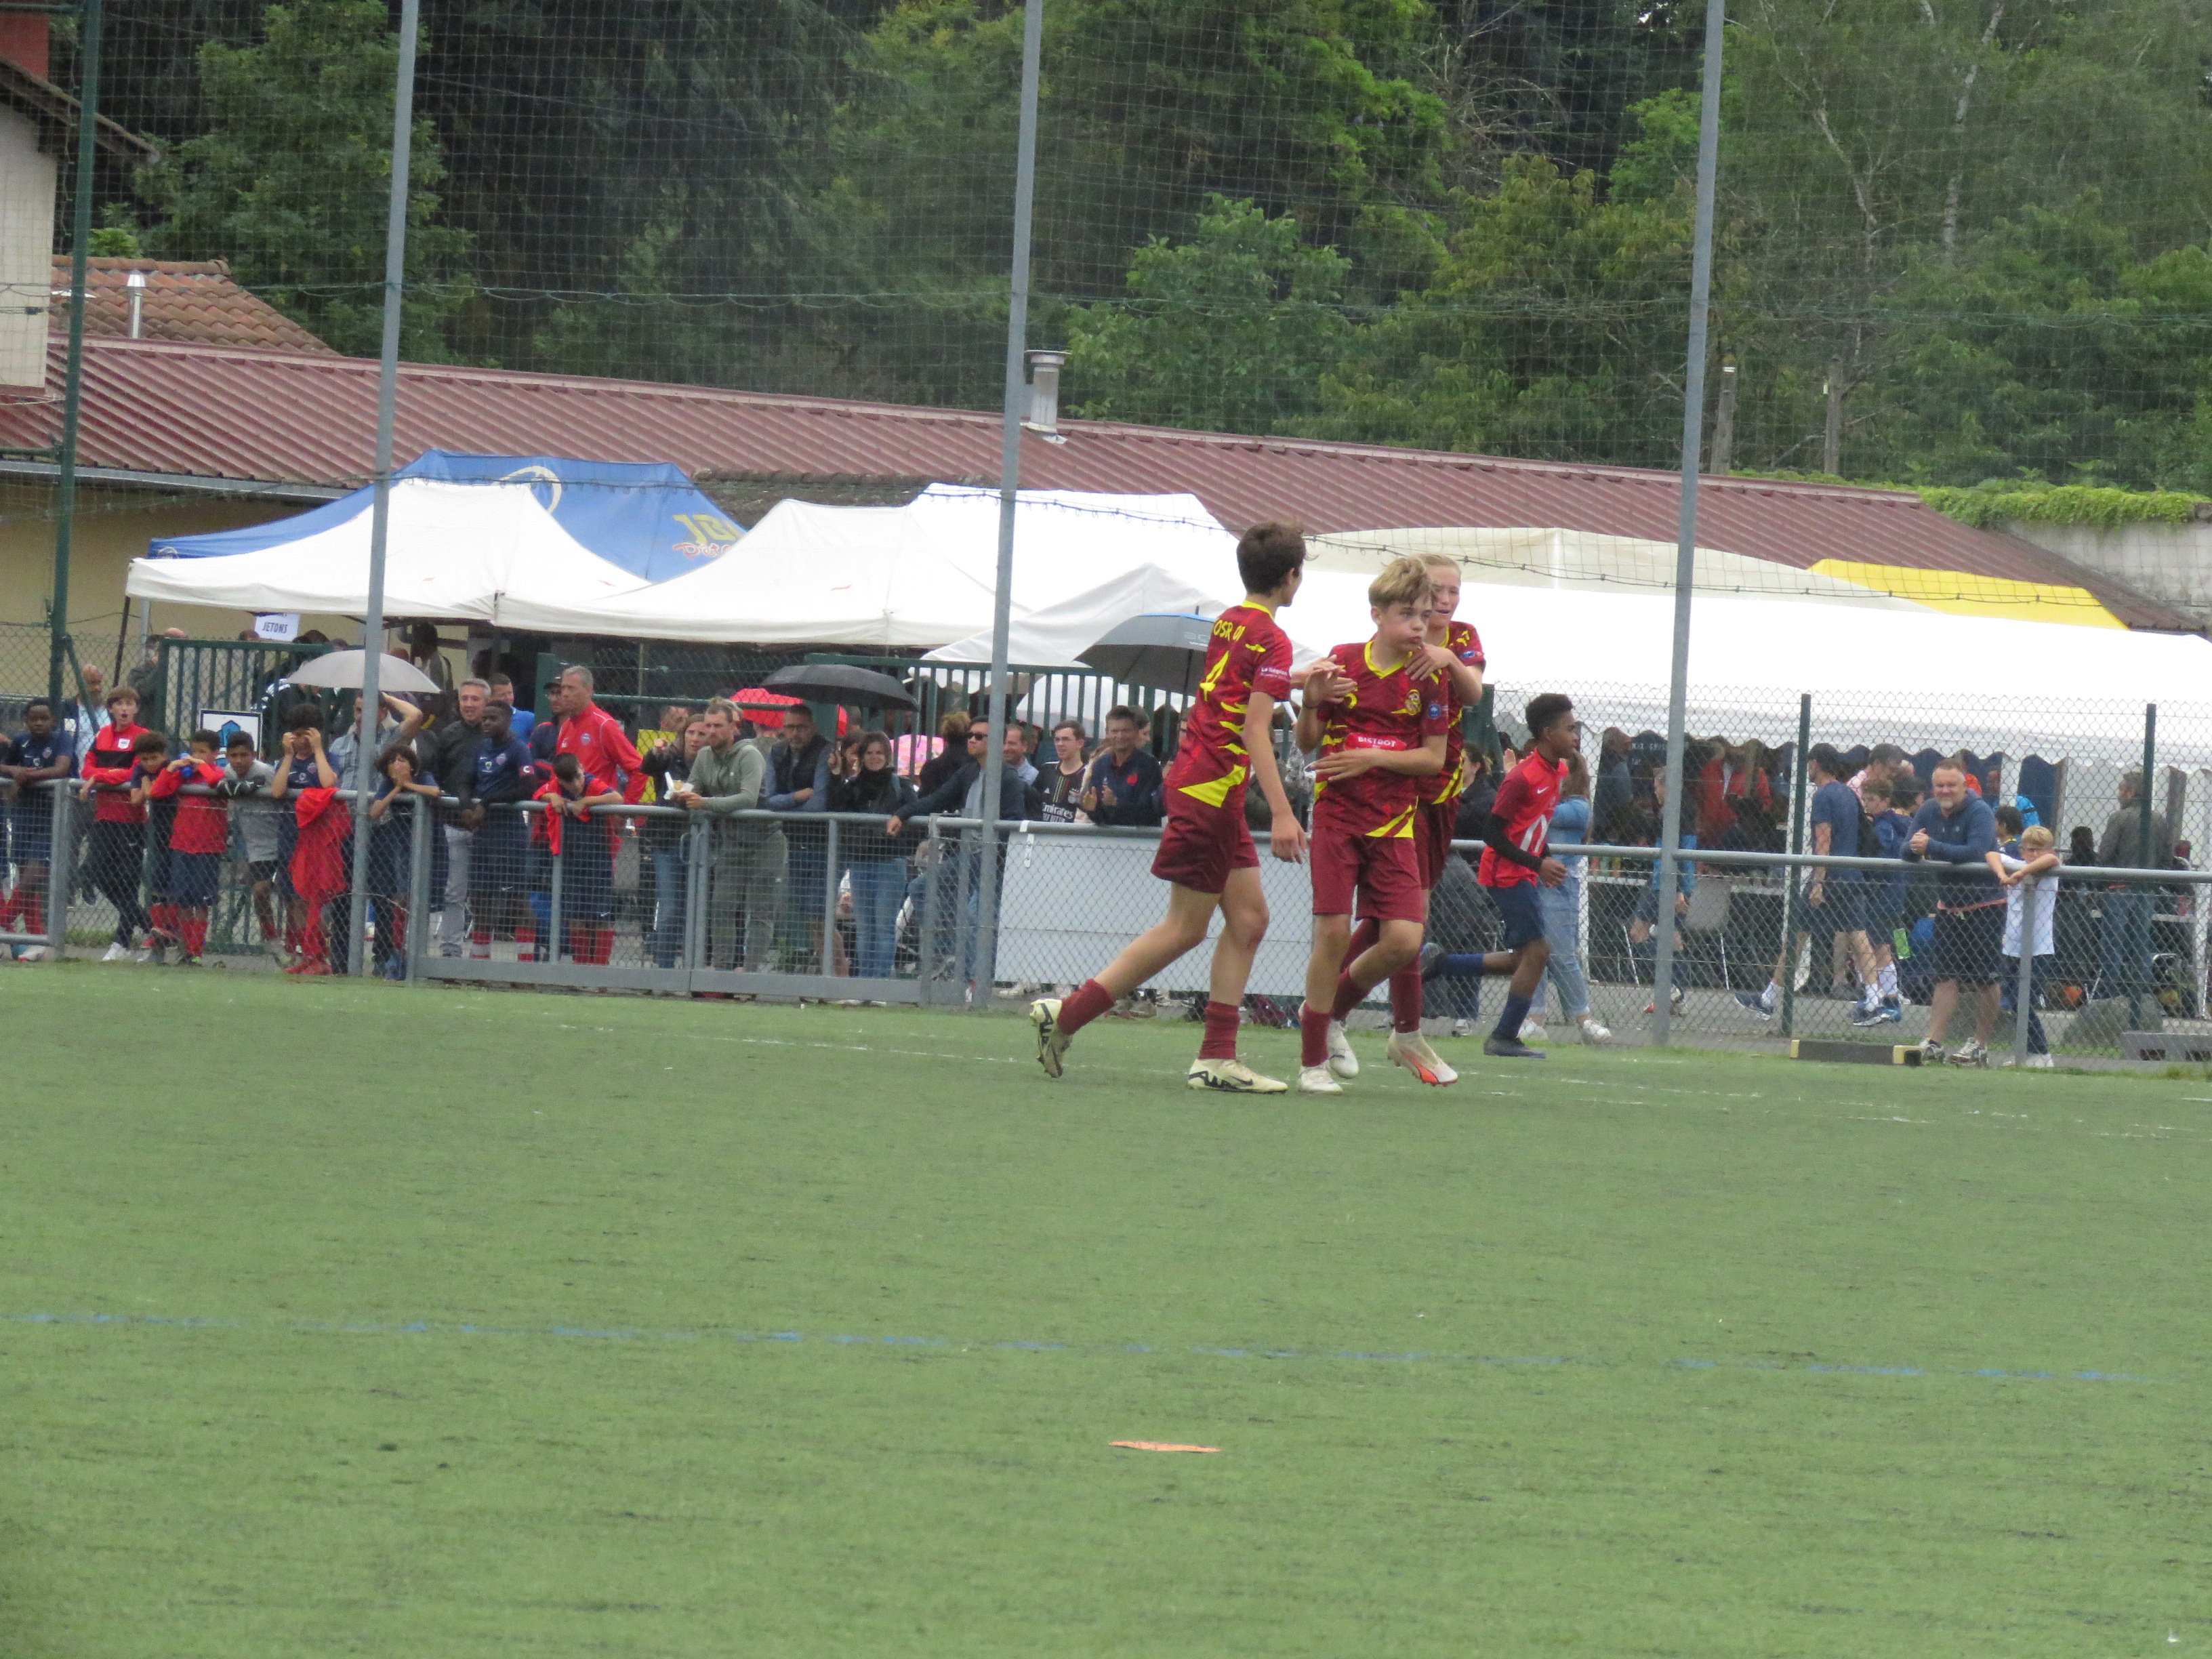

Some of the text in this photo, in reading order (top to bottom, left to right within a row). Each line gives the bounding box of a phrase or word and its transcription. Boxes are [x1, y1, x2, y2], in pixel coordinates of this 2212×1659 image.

[262, 621, 288, 634] JETONS
[1214, 619, 1233, 641] OSR
[1200, 650, 1229, 701] 4
[1357, 736, 1396, 747] BISTROT
